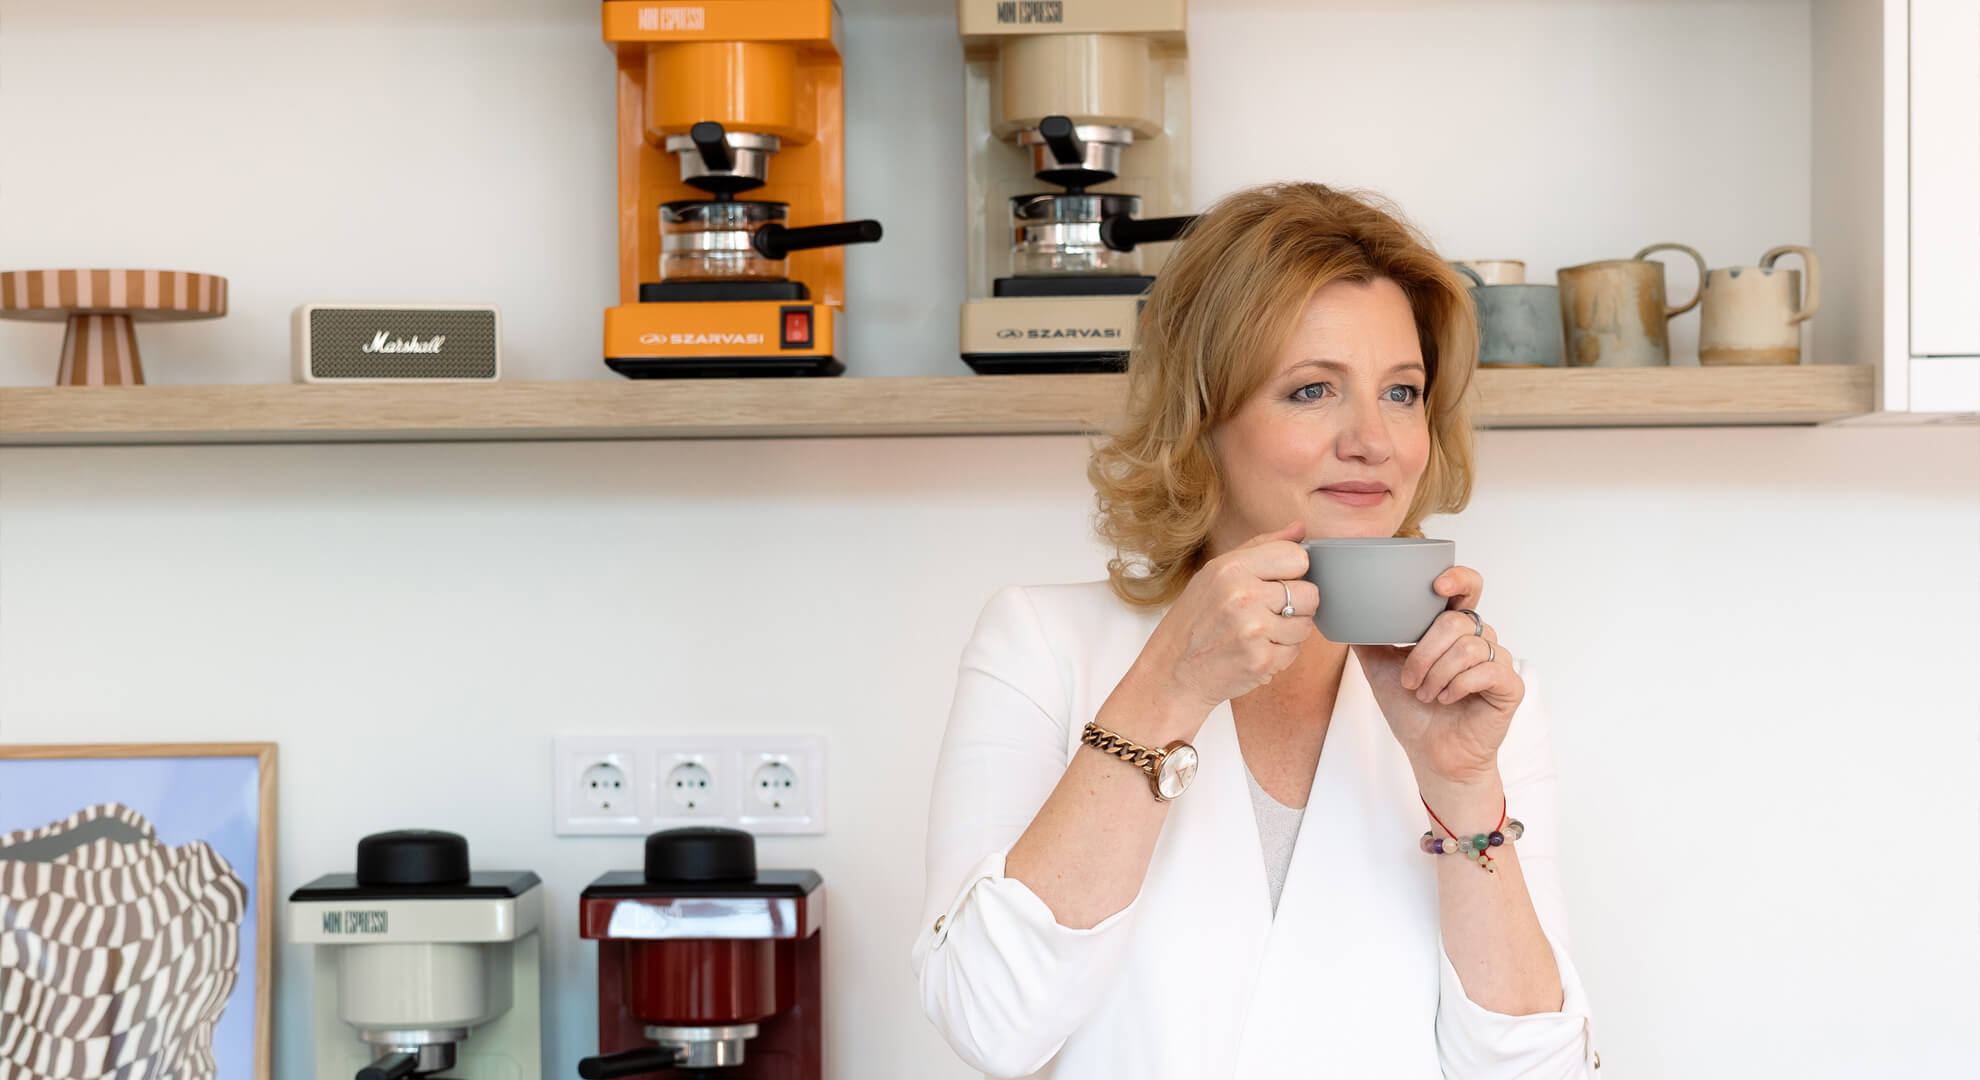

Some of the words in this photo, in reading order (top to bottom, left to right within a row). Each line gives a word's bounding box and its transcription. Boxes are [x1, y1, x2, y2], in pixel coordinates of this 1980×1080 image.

[996, 1, 1017, 23] MINI
[1020, 1, 1063, 23] ESPRESSO
[362, 329, 446, 354] Marshall
[670, 333, 765, 345] SZARVASI
[1027, 328, 1121, 339] SZARVASI
[323, 910, 342, 934] MINI
[344, 910, 388, 934] ESPRESSO
